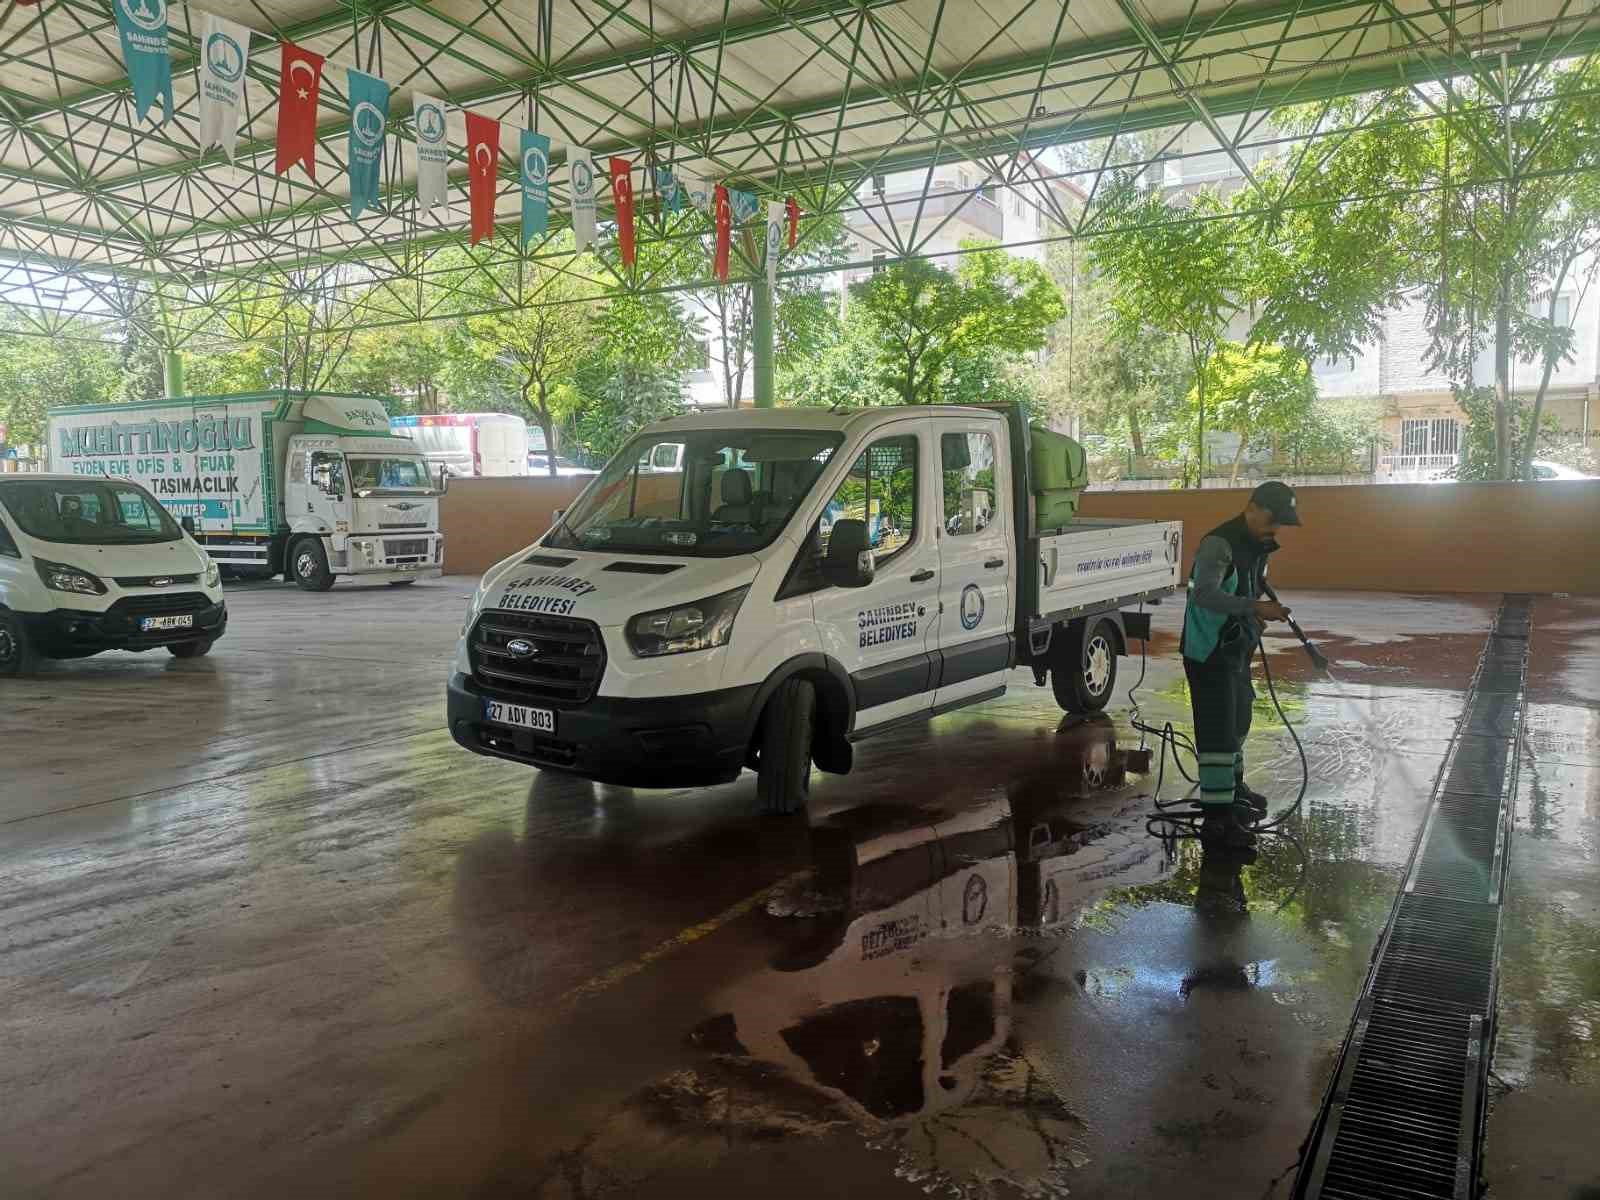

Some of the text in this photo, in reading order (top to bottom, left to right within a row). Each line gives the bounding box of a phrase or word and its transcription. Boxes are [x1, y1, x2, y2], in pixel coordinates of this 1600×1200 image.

[60, 414, 255, 457] MUHİTTİNOĞLU
[72, 459, 105, 474] EVDEN
[111, 458, 129, 475] EVE
[173, 457, 182, 473] &
[200, 455, 235, 472] FUAR
[151, 476, 239, 497] TAŞIMACILIK
[498, 594, 577, 615] BELEDİYESİ
[859, 621, 917, 648] BELEDİYESİ
[491, 703, 552, 729] 27 ADV 803
